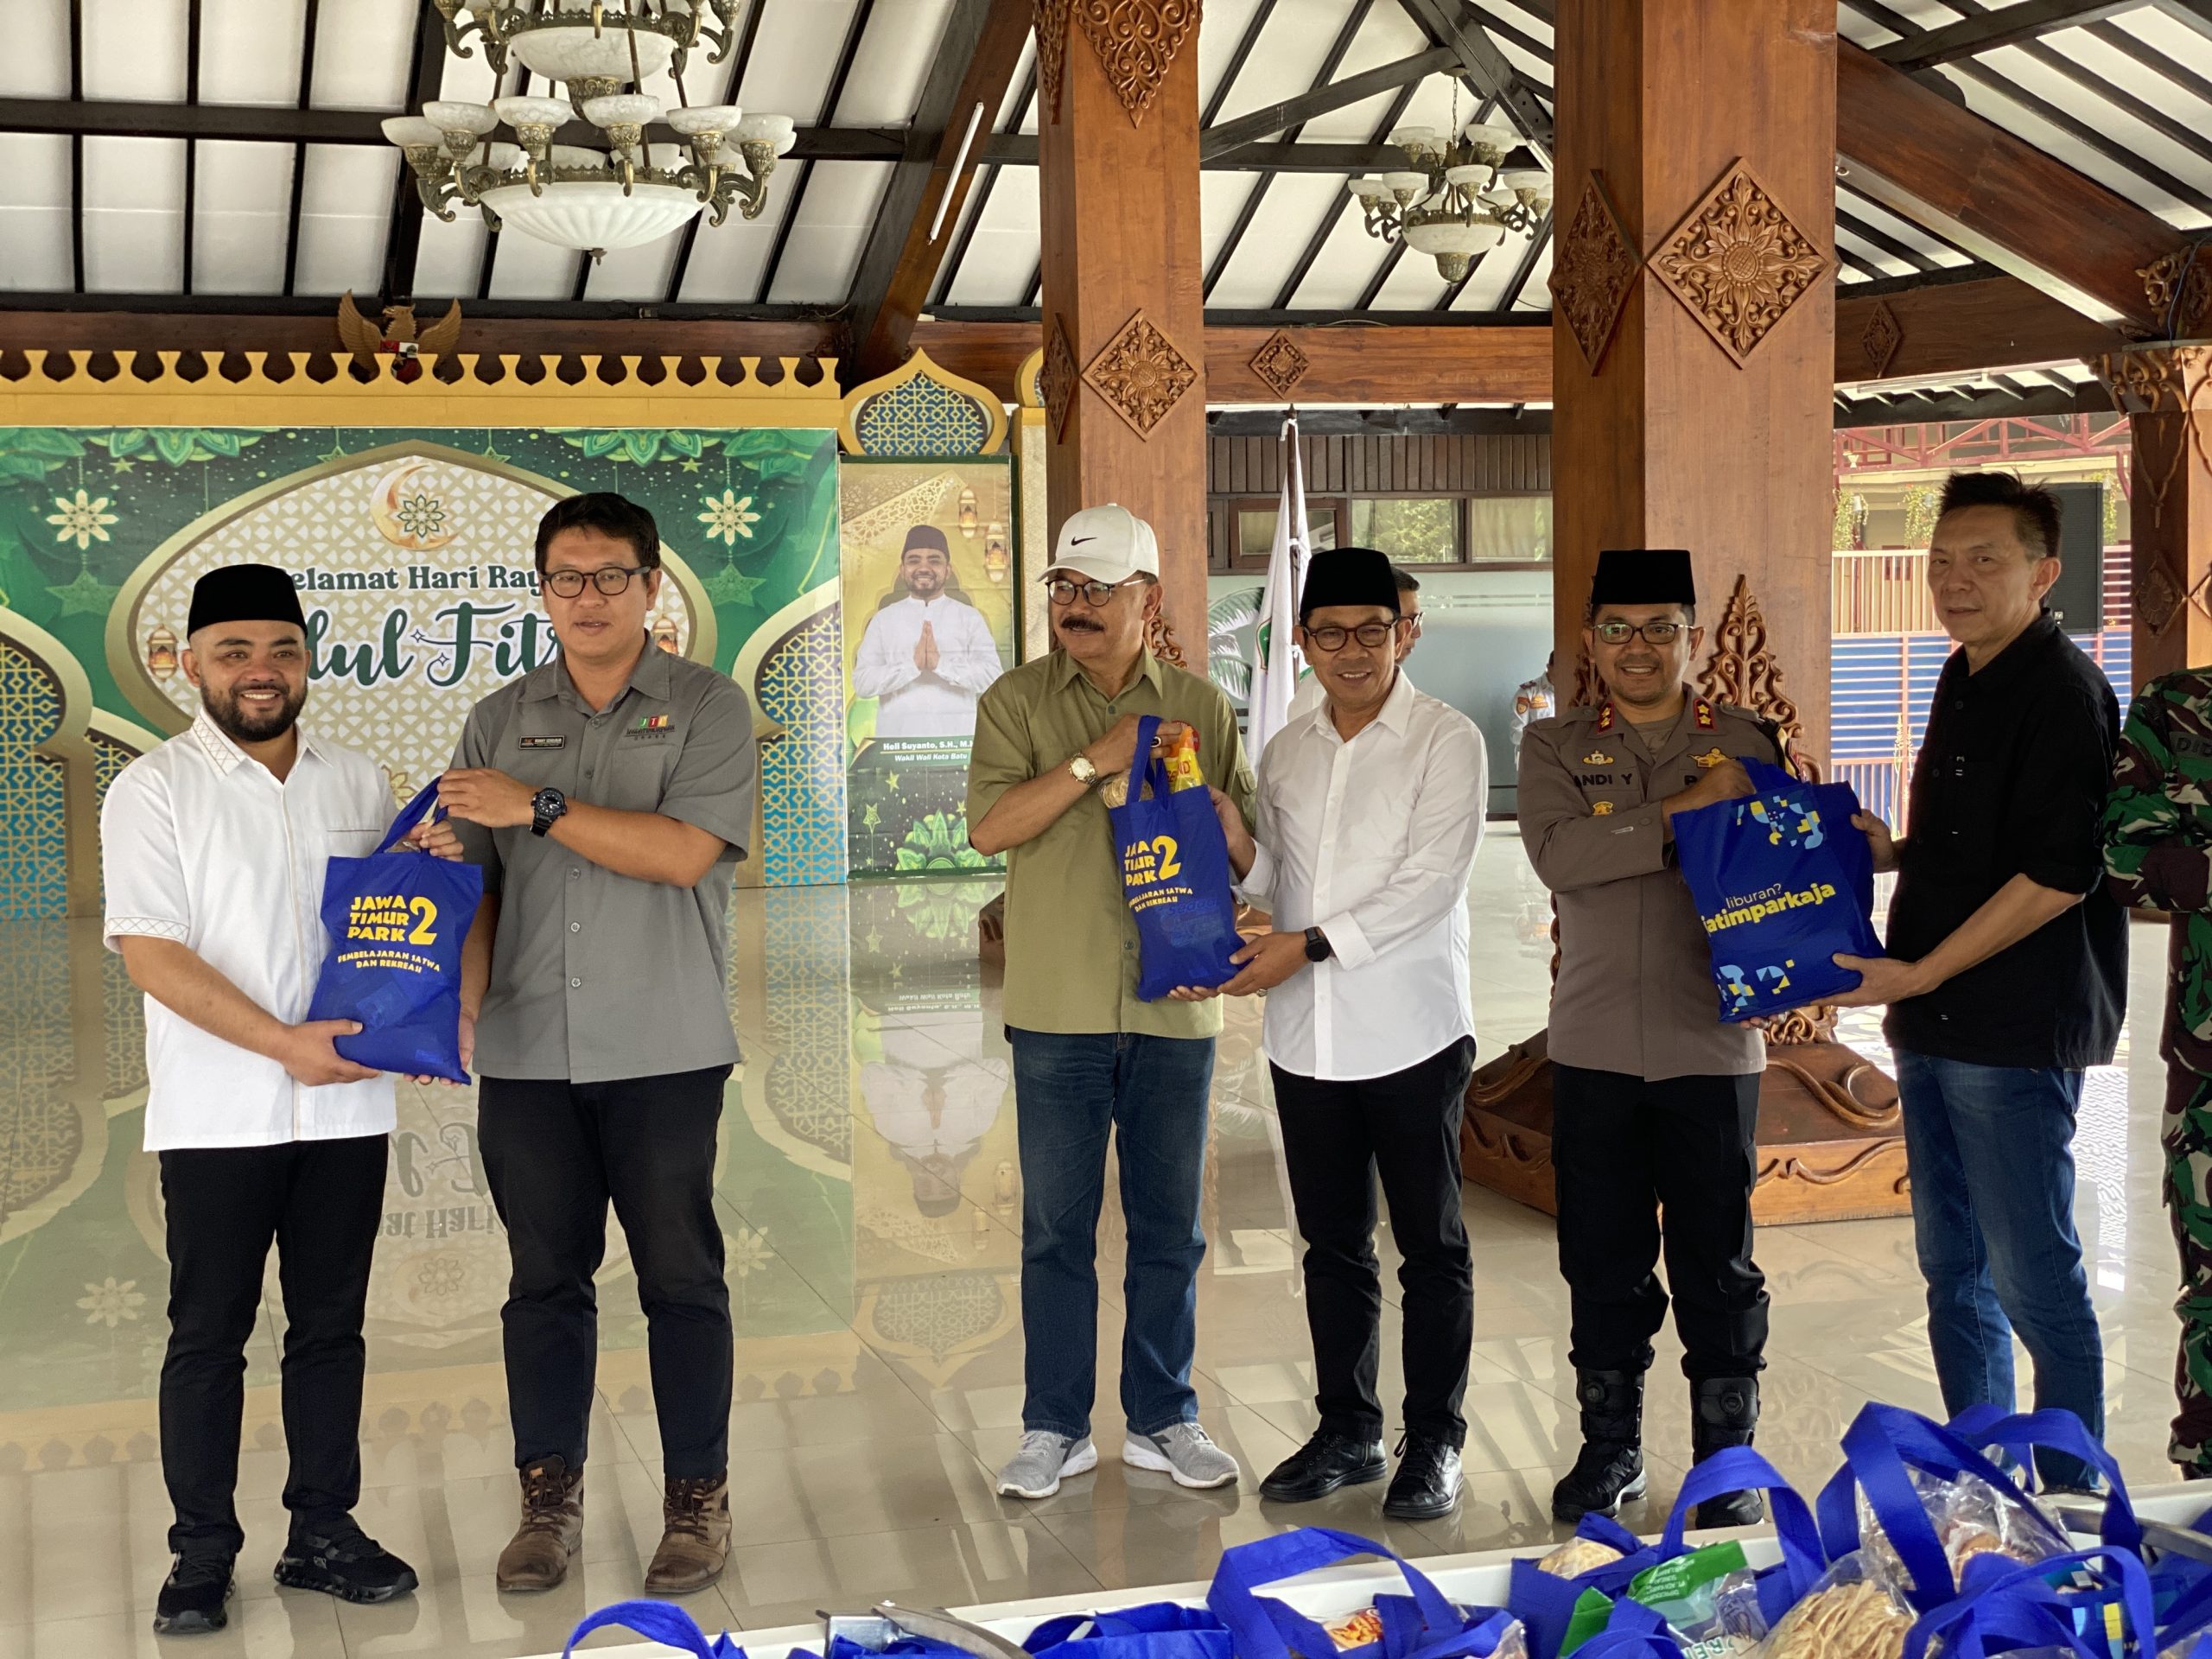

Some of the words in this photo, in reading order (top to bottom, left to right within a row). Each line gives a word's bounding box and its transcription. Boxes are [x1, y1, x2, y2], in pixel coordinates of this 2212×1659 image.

[290, 566, 399, 591] elamat
[407, 566, 479, 589] Hari
[487, 565, 543, 597] Ray
[307, 609, 415, 686] dul
[420, 601, 563, 687] Fitr
[916, 753, 931, 762] Wali
[933, 753, 950, 761] Kota
[1125, 840, 1150, 857] JAA
[1152, 835, 1181, 880] 2
[1166, 887, 1193, 895] SATWA
[1726, 882, 1783, 909] liburan?
[351, 895, 407, 911] JAWA
[1135, 902, 1147, 912] DAN
[349, 912, 410, 925] TIMUR
[409, 896, 438, 945] 2
[347, 926, 406, 942] PARK
[337, 950, 410, 963] PEMBELAJARAN
[411, 954, 441, 972] SATWA
[355, 960, 378, 969] DAN
[379, 959, 423, 973] REKREASI
